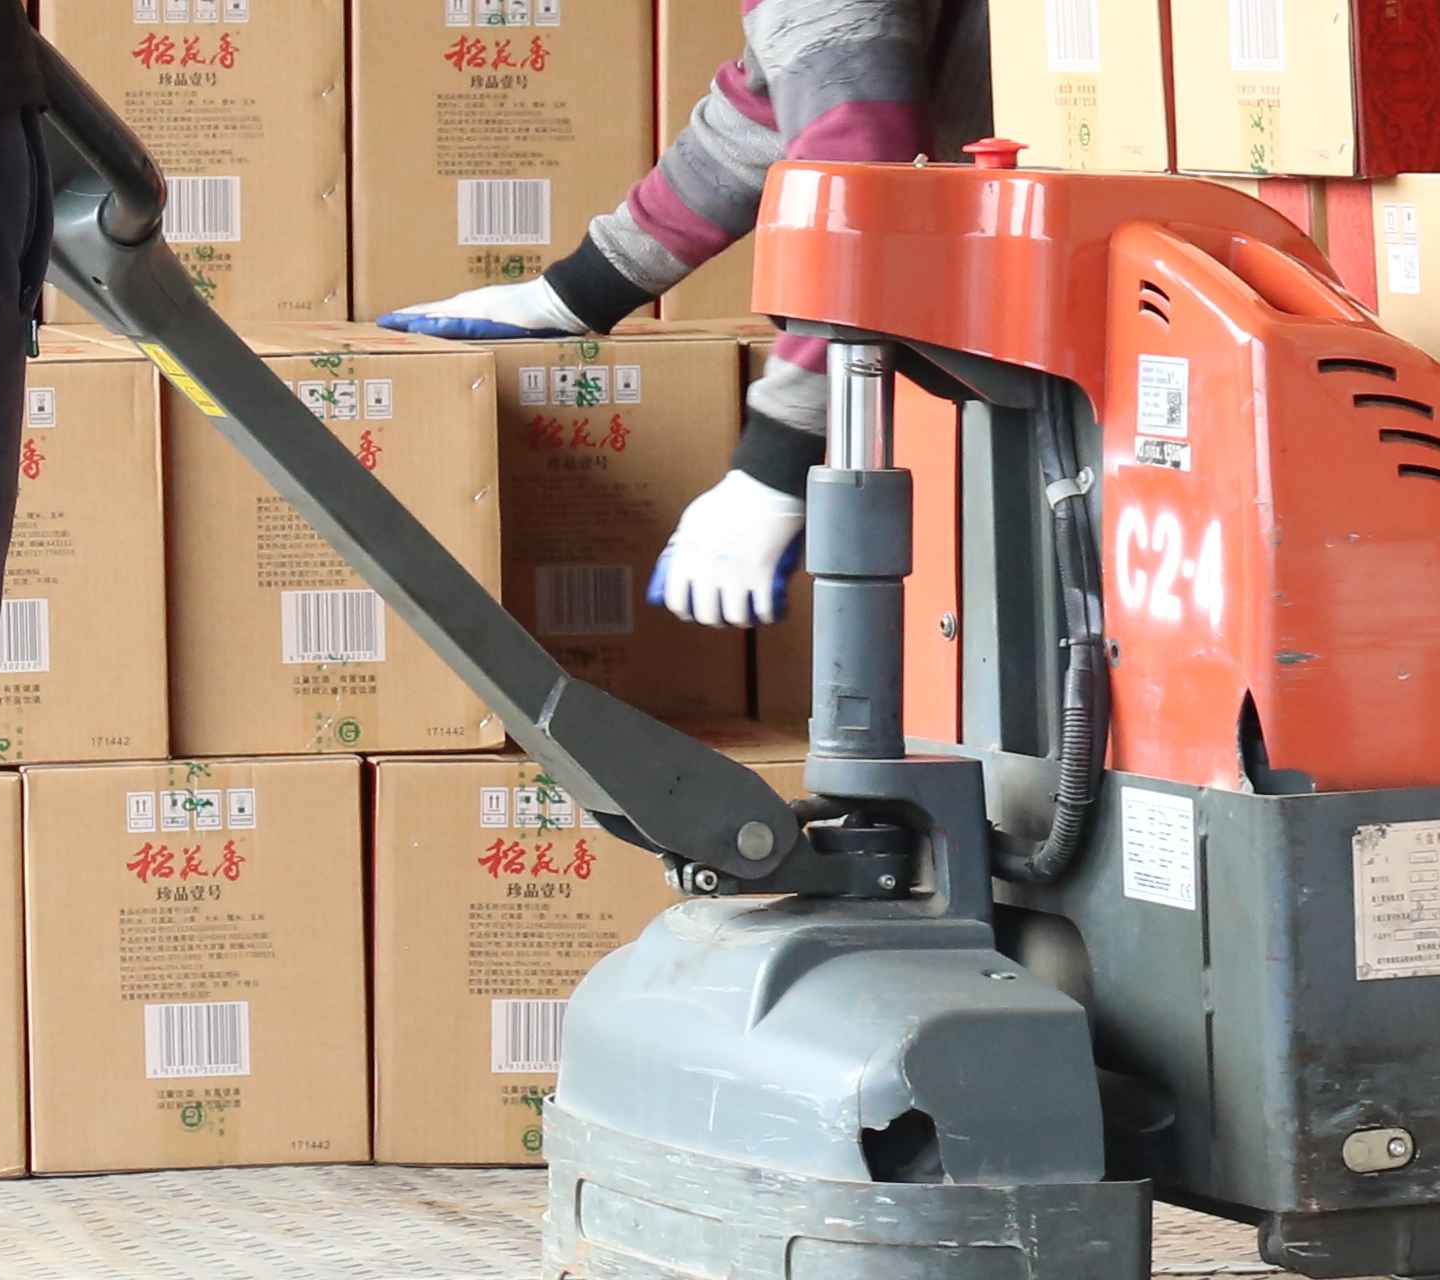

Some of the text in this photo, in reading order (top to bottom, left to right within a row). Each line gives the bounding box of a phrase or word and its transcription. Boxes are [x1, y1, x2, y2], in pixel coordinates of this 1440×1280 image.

[130, 31, 238, 70] 稻花香
[442, 34, 547, 74] 稻花香
[126, 839, 244, 882] 稻花香
[478, 835, 598, 882] 稻花香
[155, 883, 222, 903] 珍品壹号
